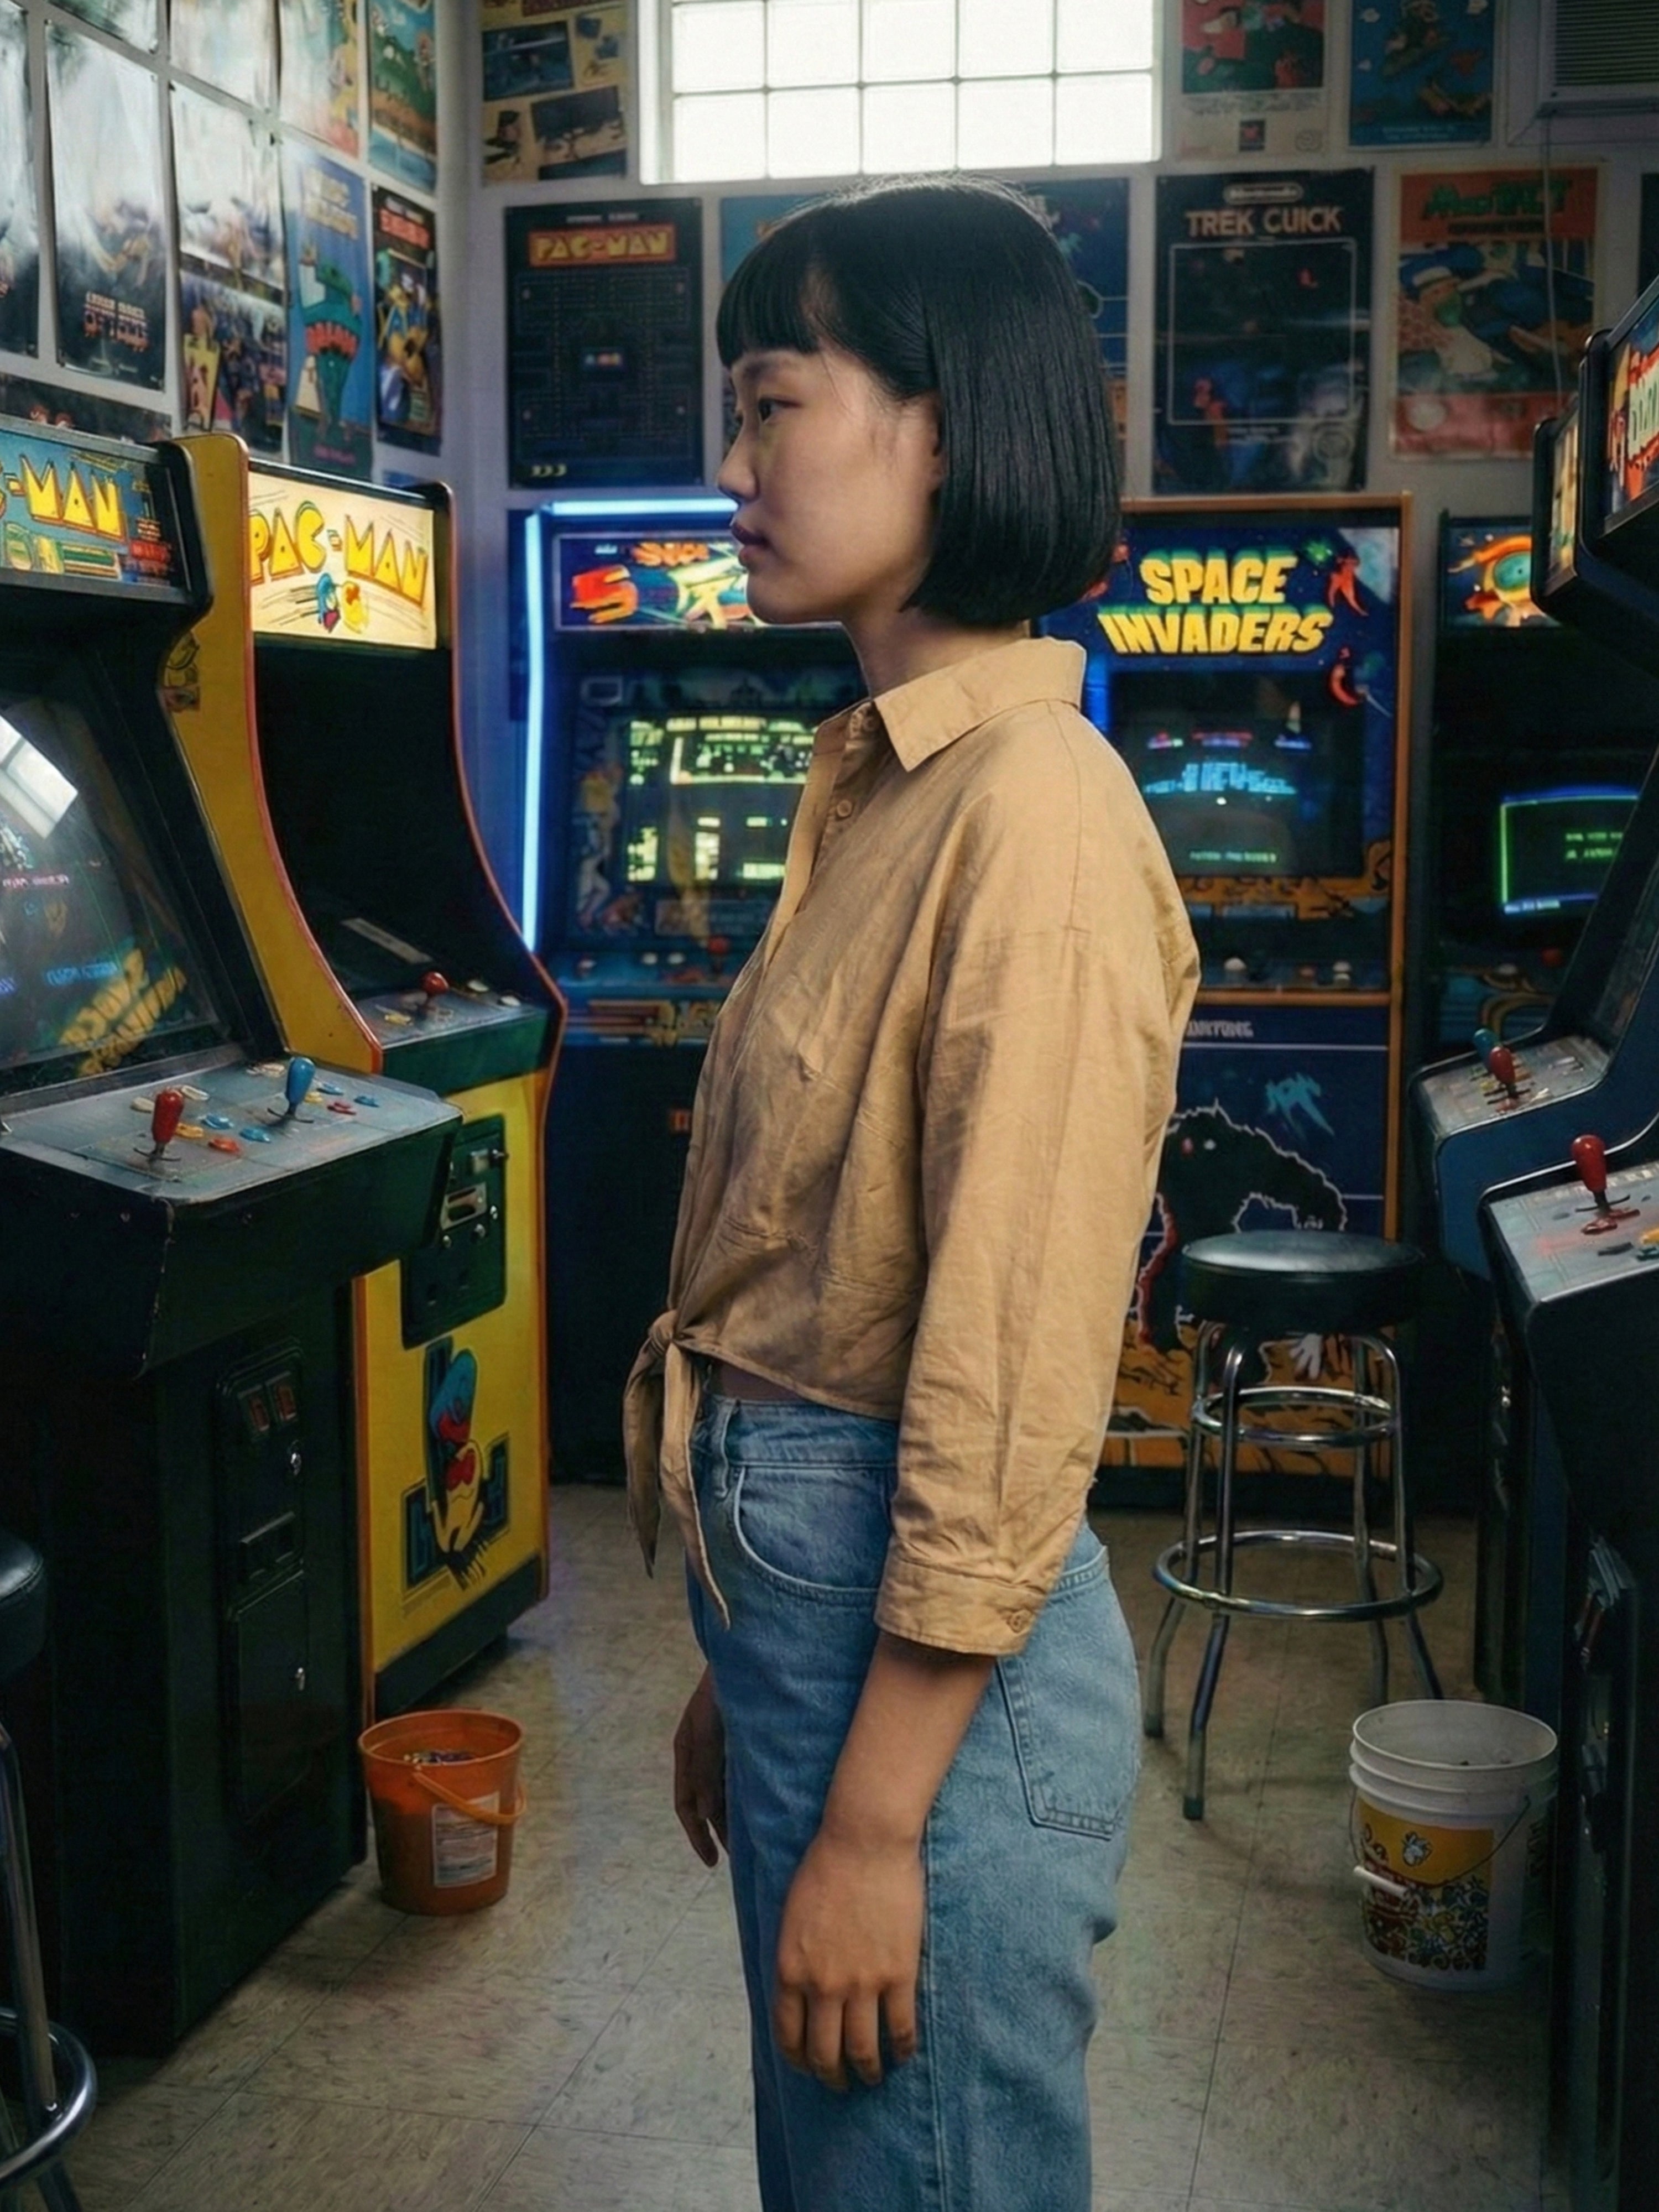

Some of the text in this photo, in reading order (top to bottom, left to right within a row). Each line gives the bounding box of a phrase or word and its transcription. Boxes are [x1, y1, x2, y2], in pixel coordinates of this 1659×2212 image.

[533, 230, 669, 260] PAC-MAN
[1186, 206, 1342, 237] TREK CUICK
[0, 452, 127, 545] -MAN
[249, 500, 429, 611] PAC-MAN
[1139, 551, 1298, 604] SPACE
[1097, 607, 1334, 654] INVADERS
